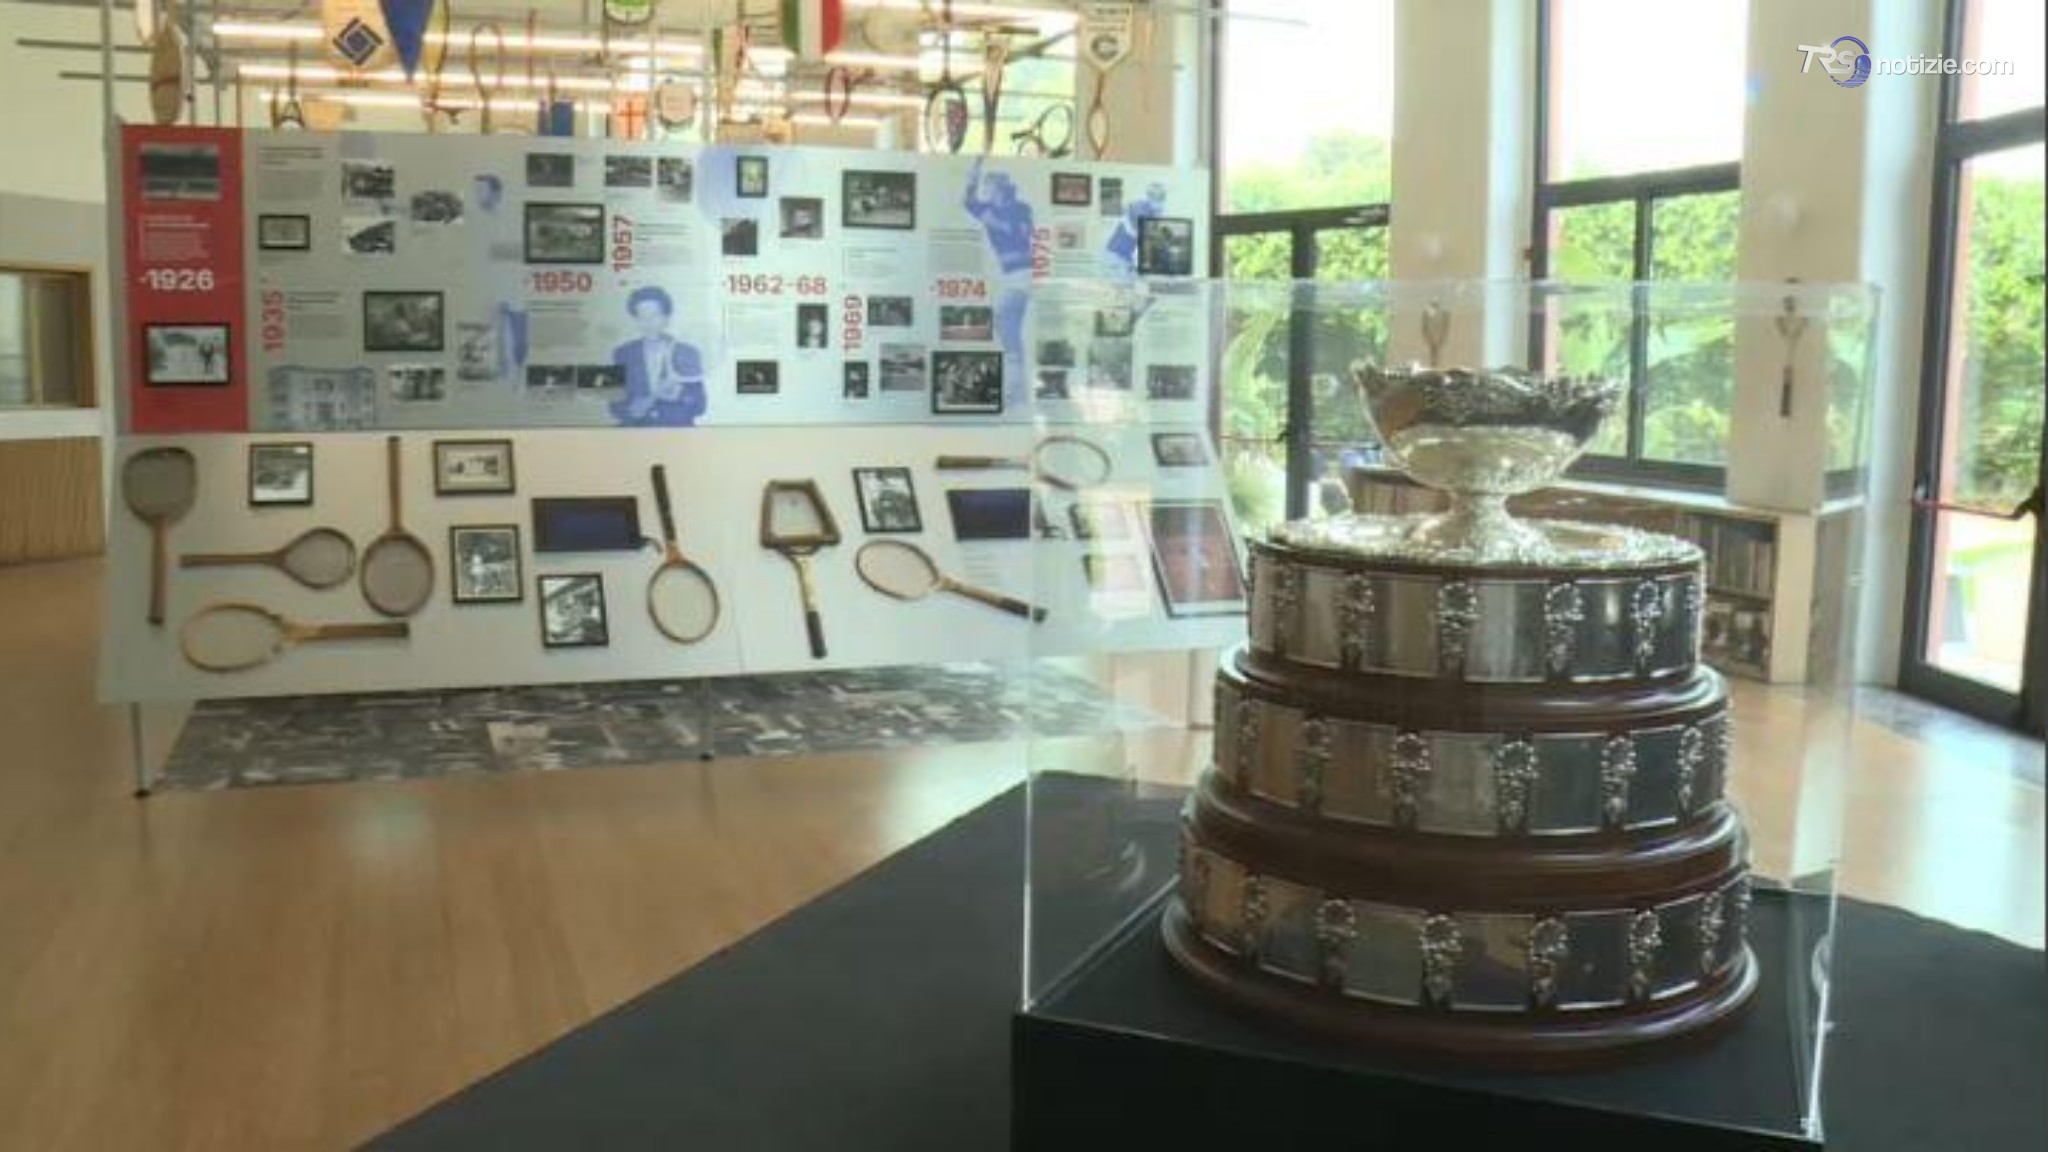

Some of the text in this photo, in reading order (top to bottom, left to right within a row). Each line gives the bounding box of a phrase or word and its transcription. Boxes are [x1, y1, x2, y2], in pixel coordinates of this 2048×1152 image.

[613, 214, 633, 272] 1957
[1031, 227, 1050, 277] 1975
[146, 267, 215, 291] 1926
[532, 271, 593, 293] 1950
[936, 278, 986, 298] 1974
[261, 290, 286, 351] 1935
[844, 294, 863, 351] 1969
